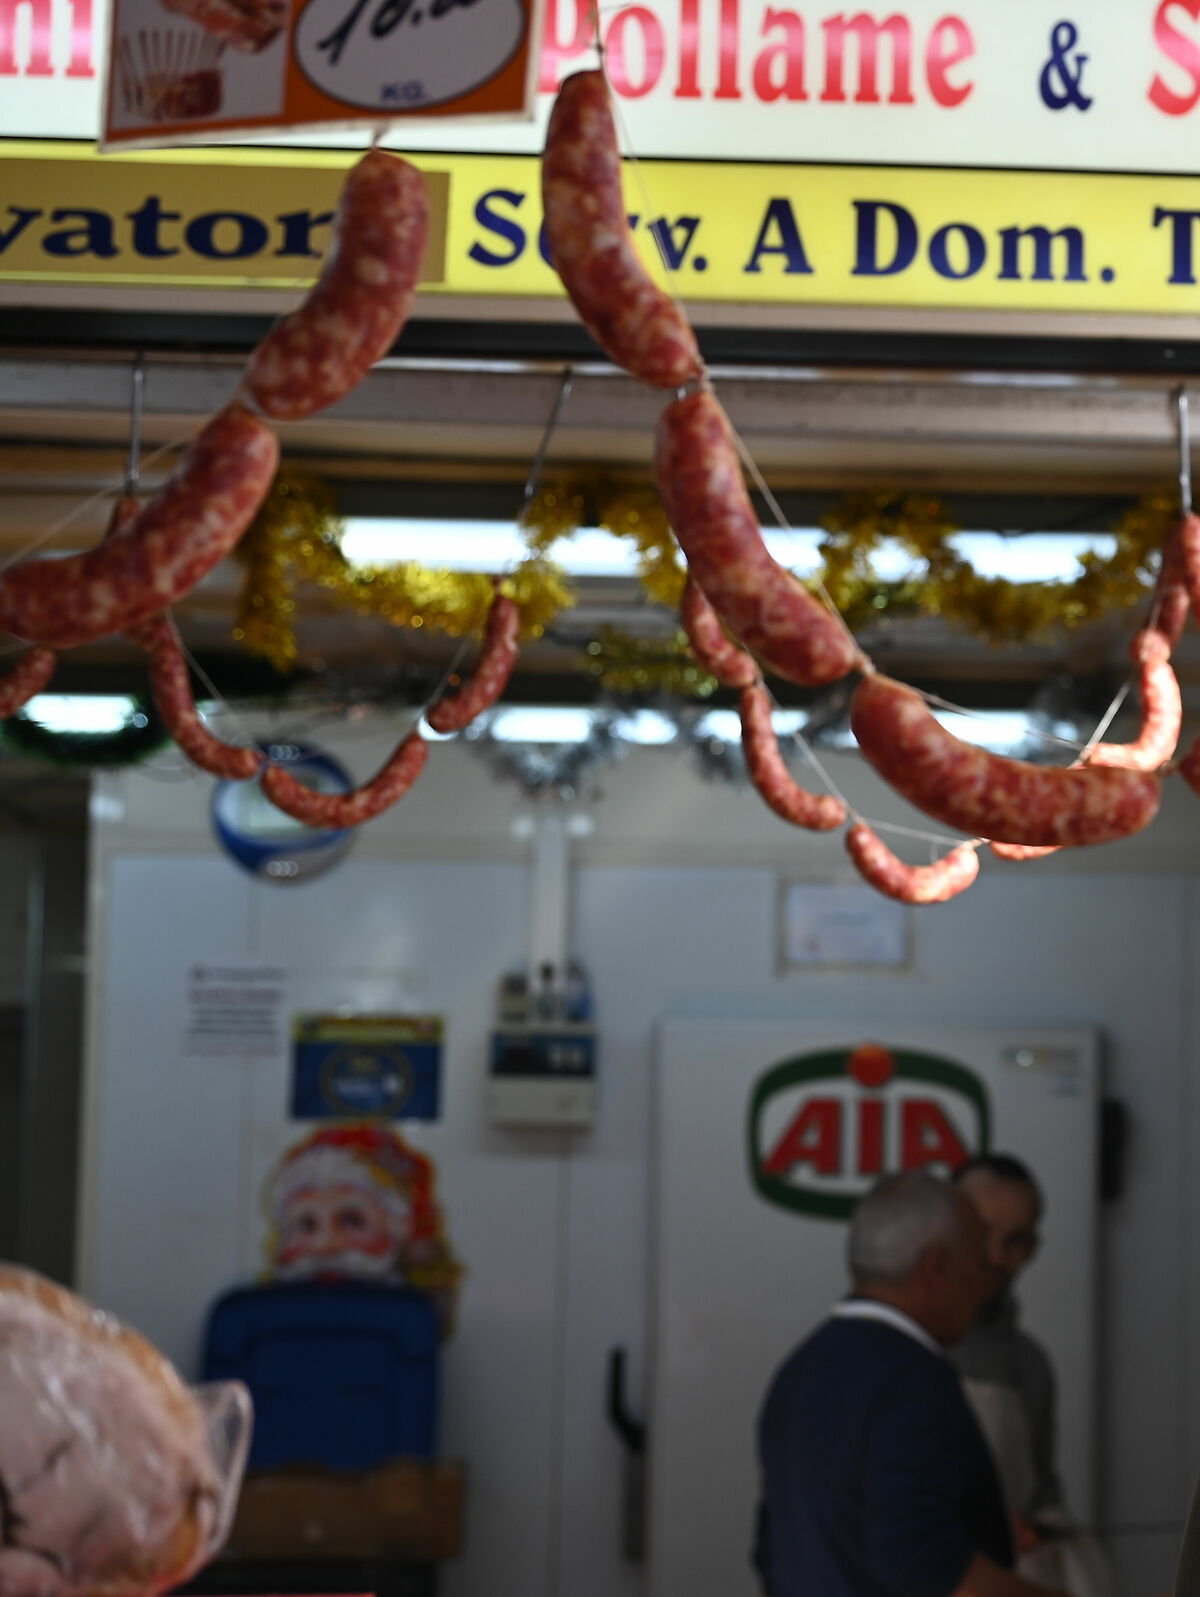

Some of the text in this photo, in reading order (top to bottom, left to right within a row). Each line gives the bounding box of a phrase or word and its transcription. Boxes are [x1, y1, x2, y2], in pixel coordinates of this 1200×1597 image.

[538, 0, 976, 108] Pollame
[1038, 20, 1094, 113] &
[467, 187, 708, 272] Sv.
[743, 196, 814, 274] A
[851, 199, 1115, 284] Dom.
